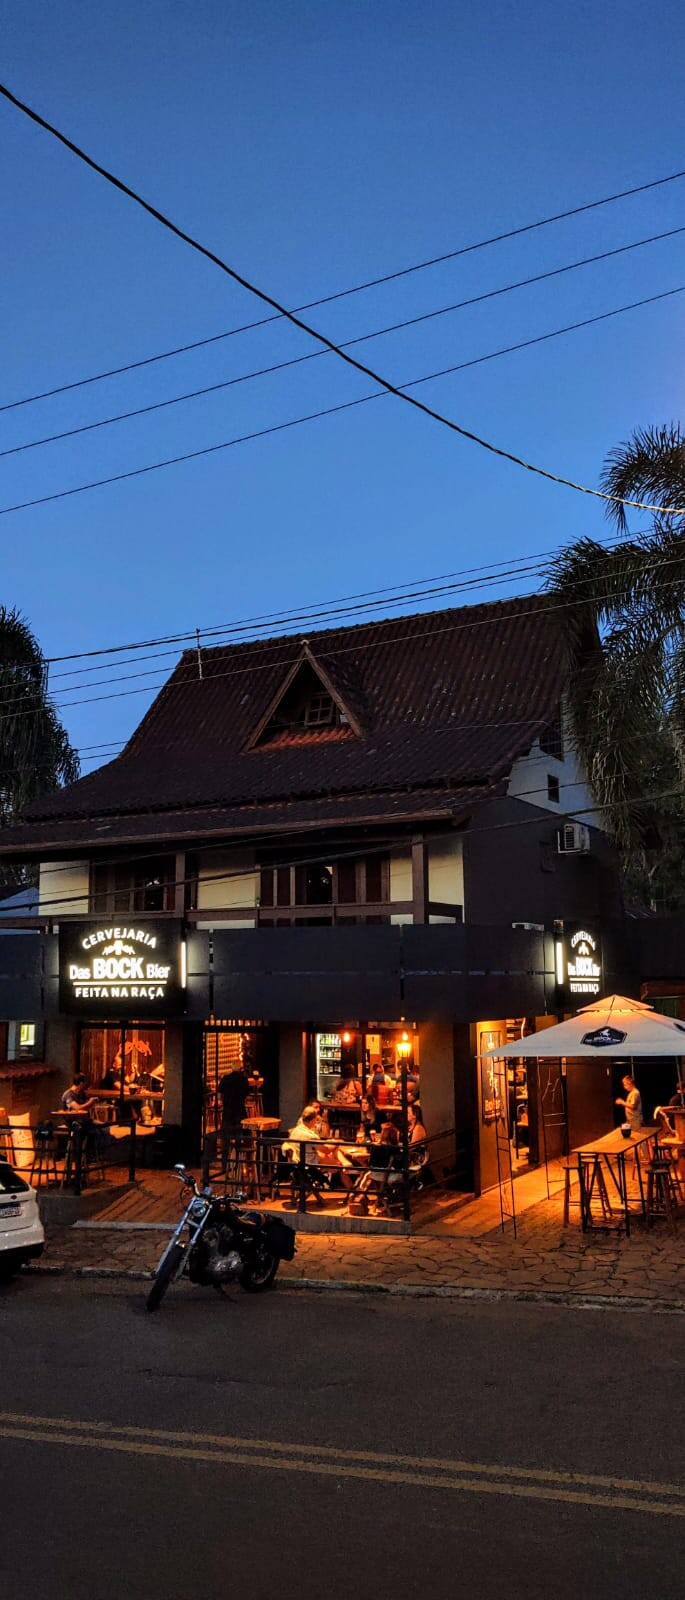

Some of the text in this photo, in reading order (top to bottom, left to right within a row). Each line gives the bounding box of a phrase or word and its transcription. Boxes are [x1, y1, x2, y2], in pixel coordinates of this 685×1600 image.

[82, 927, 157, 950] CERVEJARIA
[69, 957, 171, 980] Das BOCK Bier
[75, 987, 165, 1000] FEITA NA RAÇA
